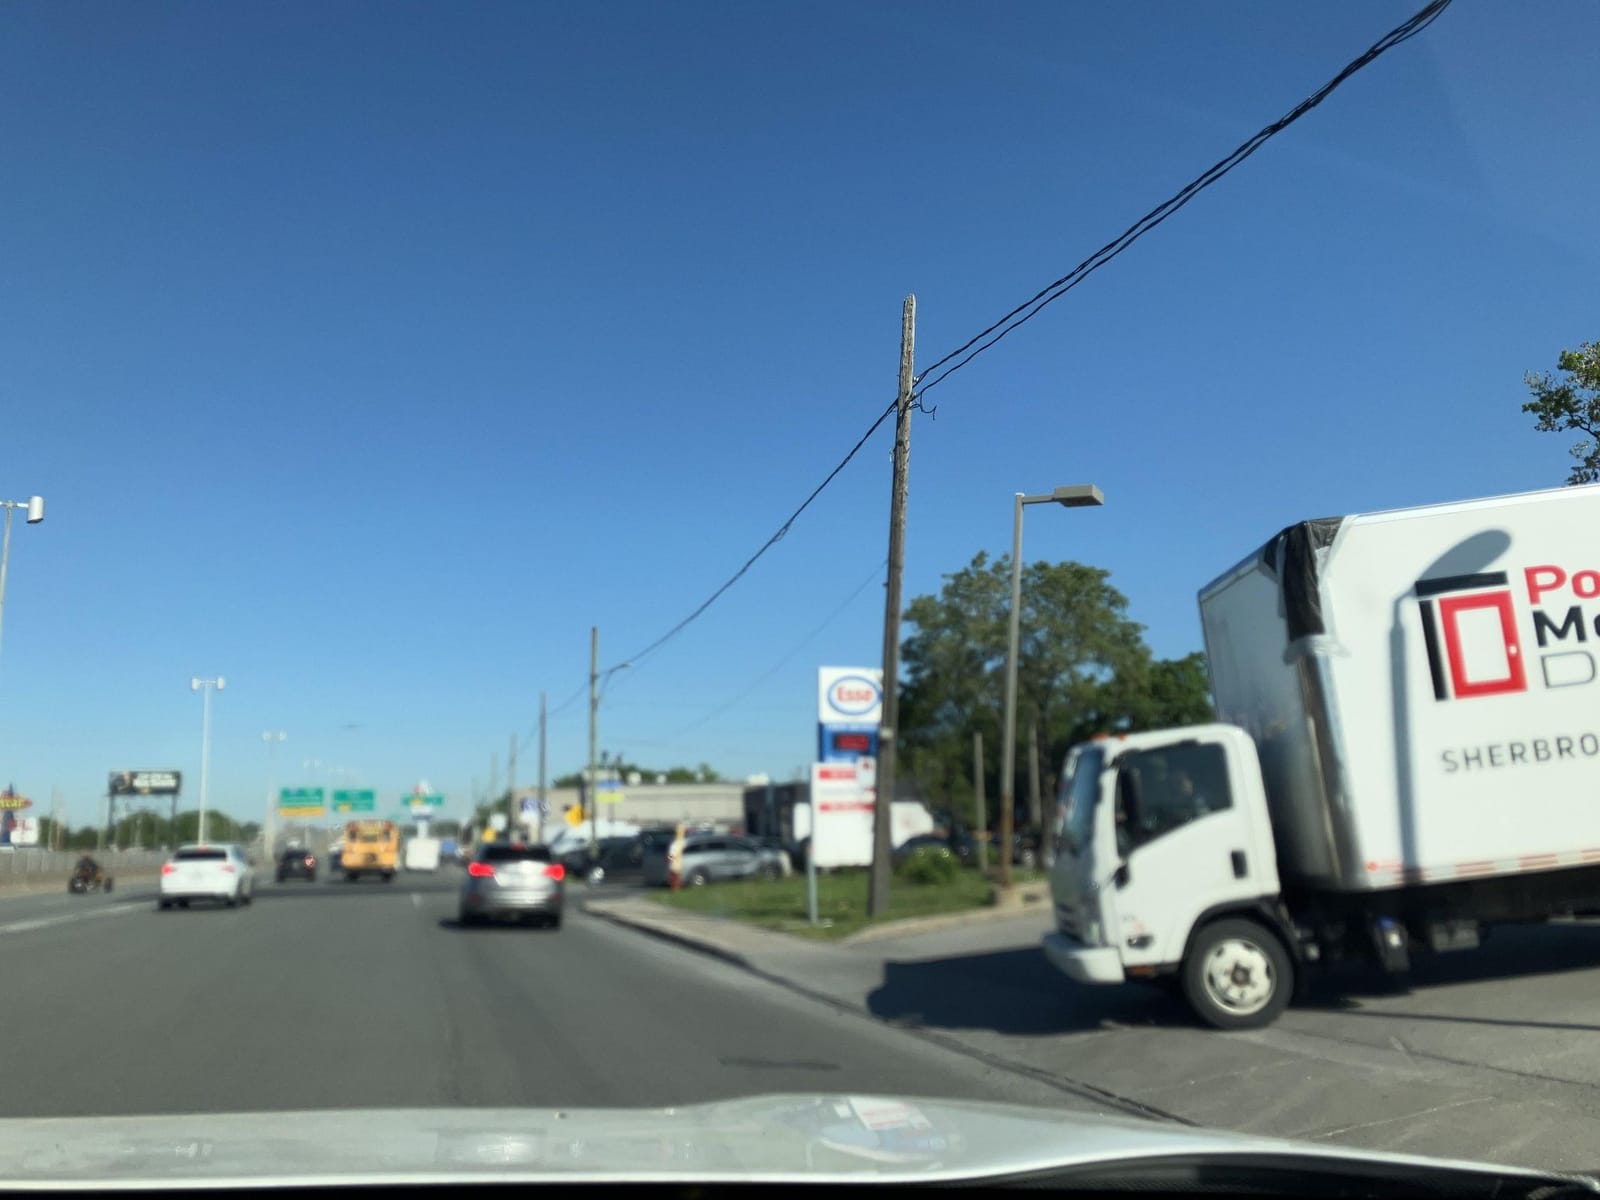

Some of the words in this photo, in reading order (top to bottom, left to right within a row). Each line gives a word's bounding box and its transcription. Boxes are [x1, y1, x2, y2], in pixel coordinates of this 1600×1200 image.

[1524, 564, 1600, 605] Po
[1533, 605, 1600, 647] M
[1441, 733, 1600, 773] SHERBRO
